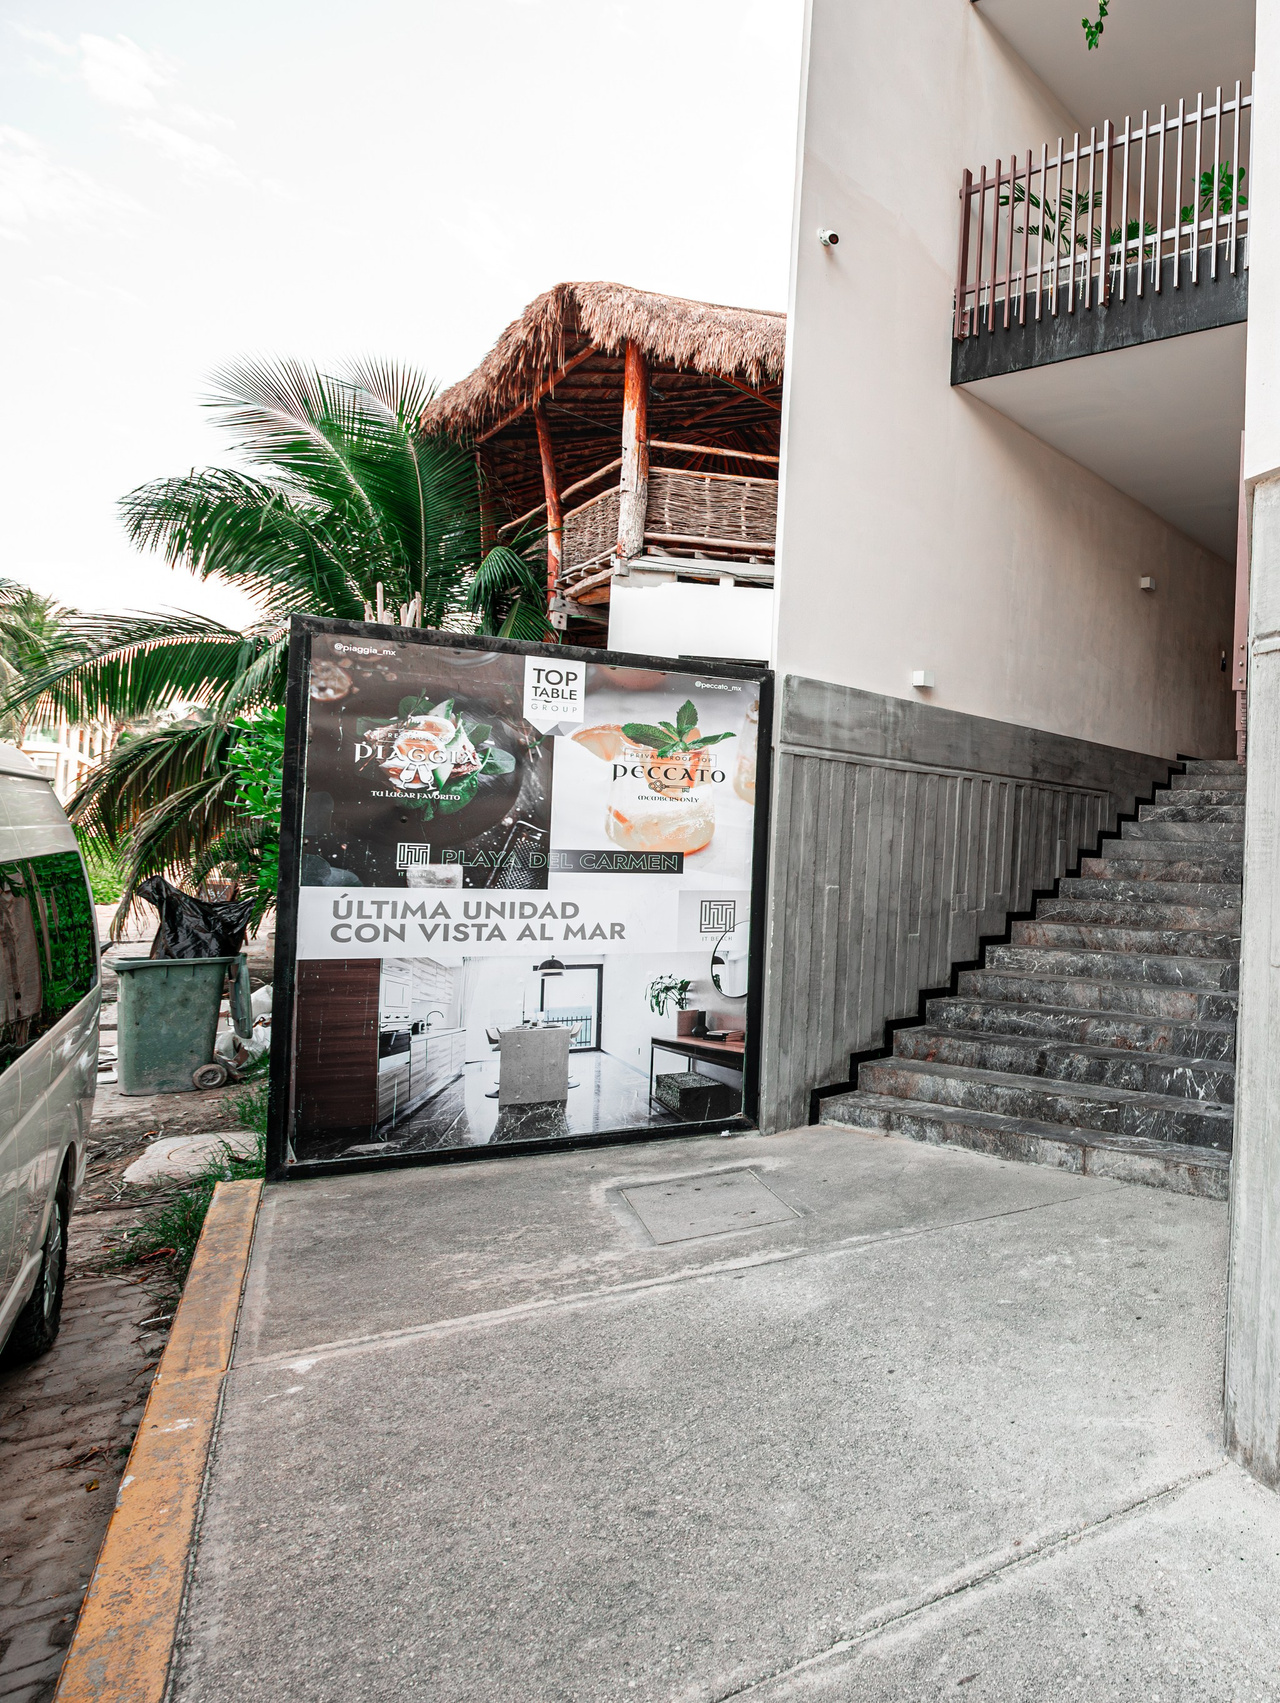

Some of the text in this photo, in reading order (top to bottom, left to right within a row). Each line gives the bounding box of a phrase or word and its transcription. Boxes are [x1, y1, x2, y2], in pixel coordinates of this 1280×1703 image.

[334, 642, 397, 656] @piaggia_mx
[533, 667, 578, 687] TOP
[695, 680, 742, 692] @peccato_mx
[531, 685, 578, 700] TABLE
[530, 703, 578, 713] GROUP
[354, 740, 479, 766] PIAGGIA
[612, 763, 726, 783] PECCATO
[385, 790, 416, 799] LUGAR
[417, 791, 461, 801] FAVORITO
[441, 849, 678, 871] PLAYA DEL CARMEN
[332, 893, 580, 920] ÚLTIMA UNIDAD
[330, 922, 626, 943] CON VISTA AL MAR
